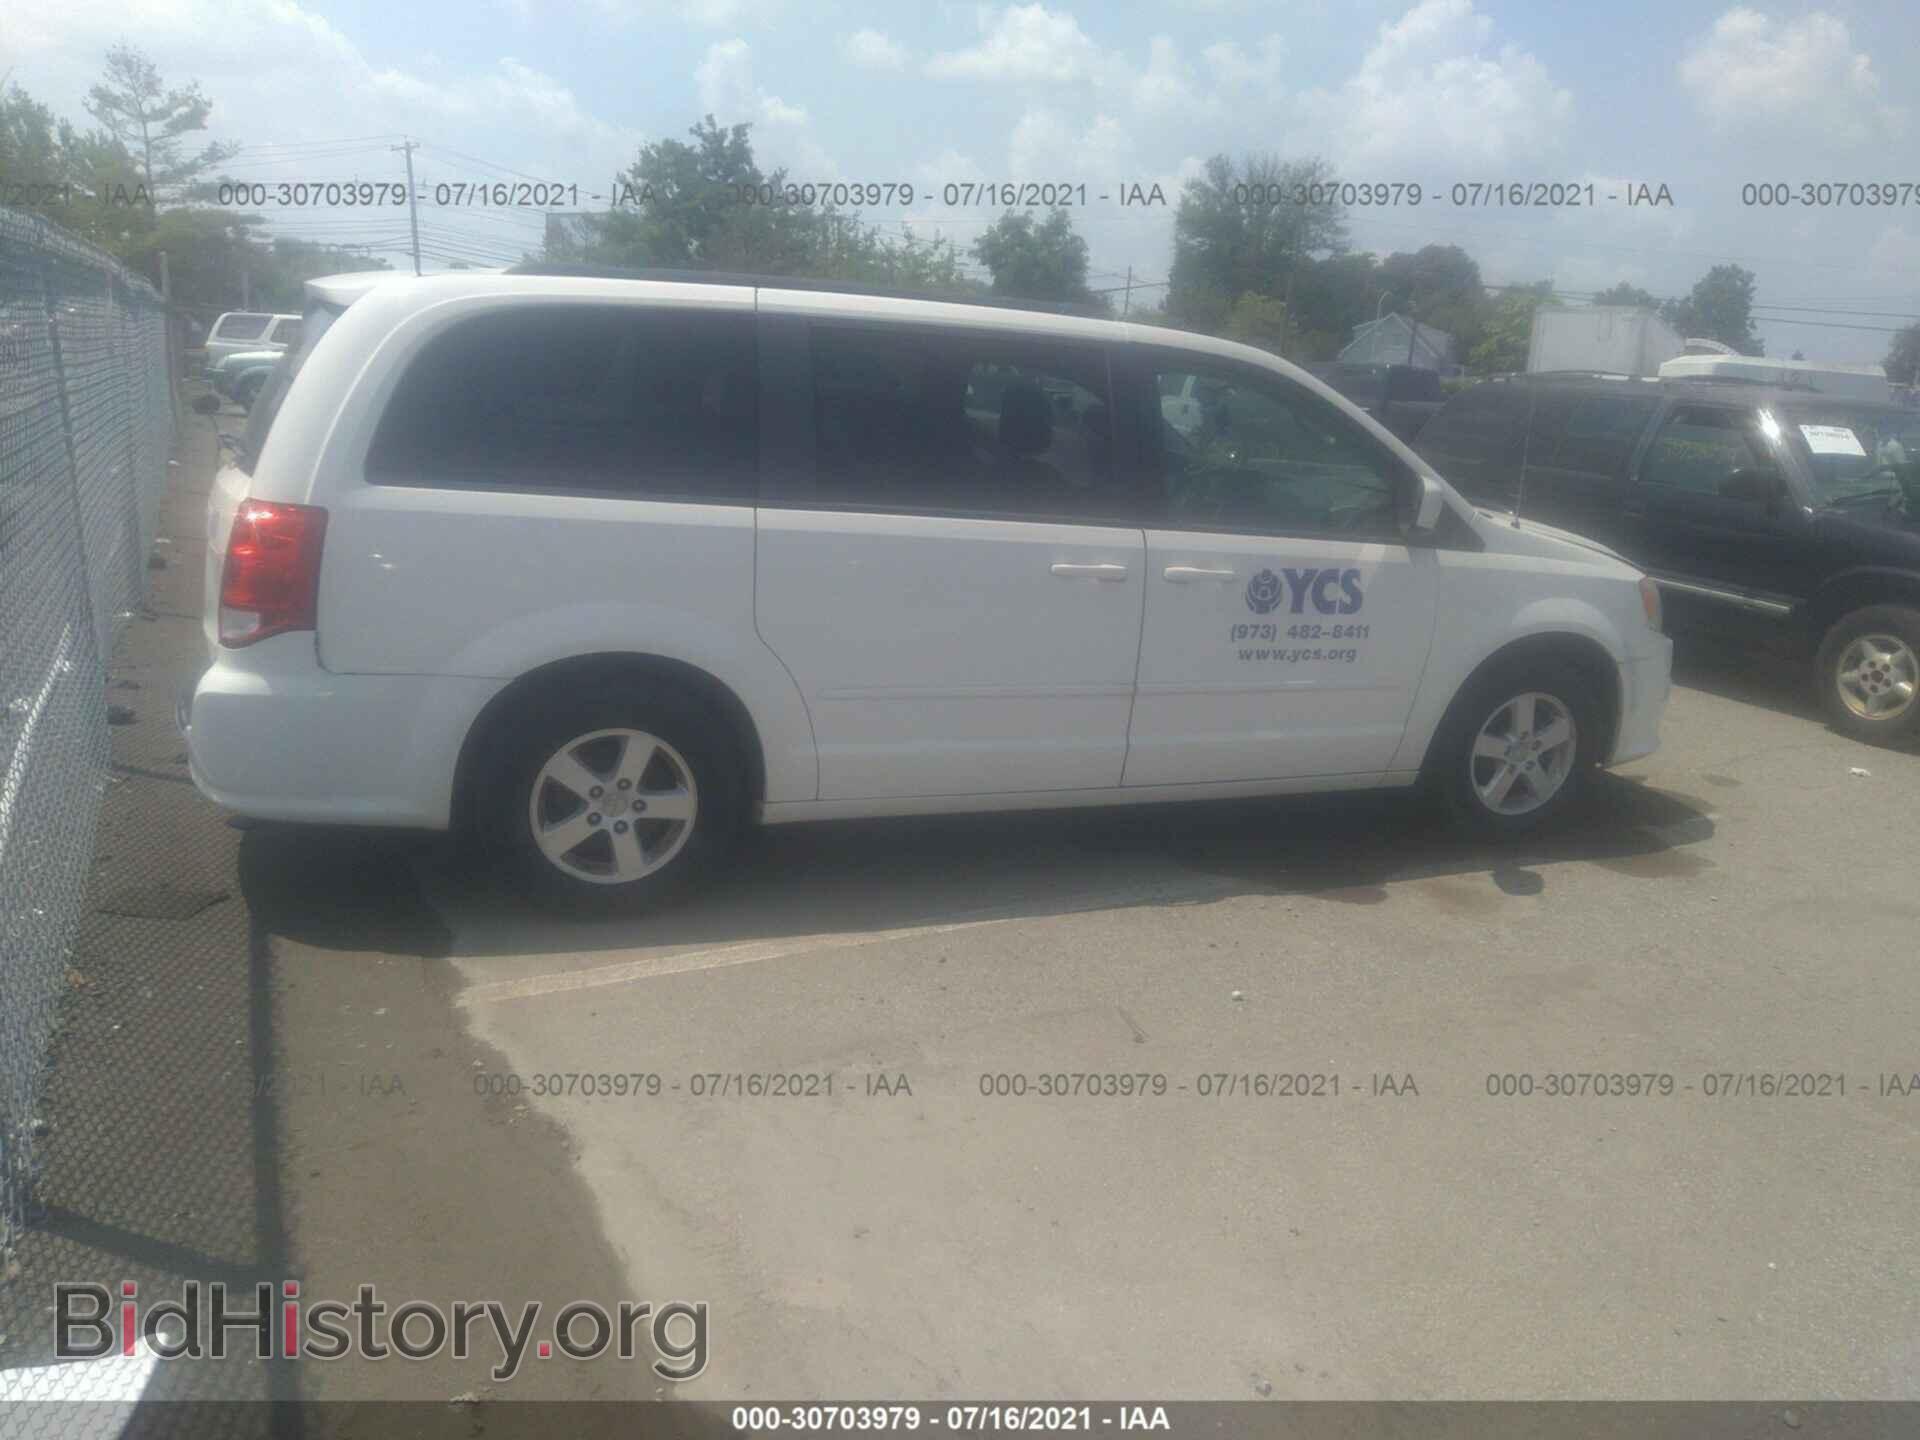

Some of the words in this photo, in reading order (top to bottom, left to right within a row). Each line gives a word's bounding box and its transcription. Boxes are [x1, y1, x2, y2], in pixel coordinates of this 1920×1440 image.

[1281, 568, 1362, 615] YCS
[1231, 624, 1277, 642] (973)
[1286, 624, 1370, 640] 482-8411
[1239, 648, 1357, 662] www.ycs.org
